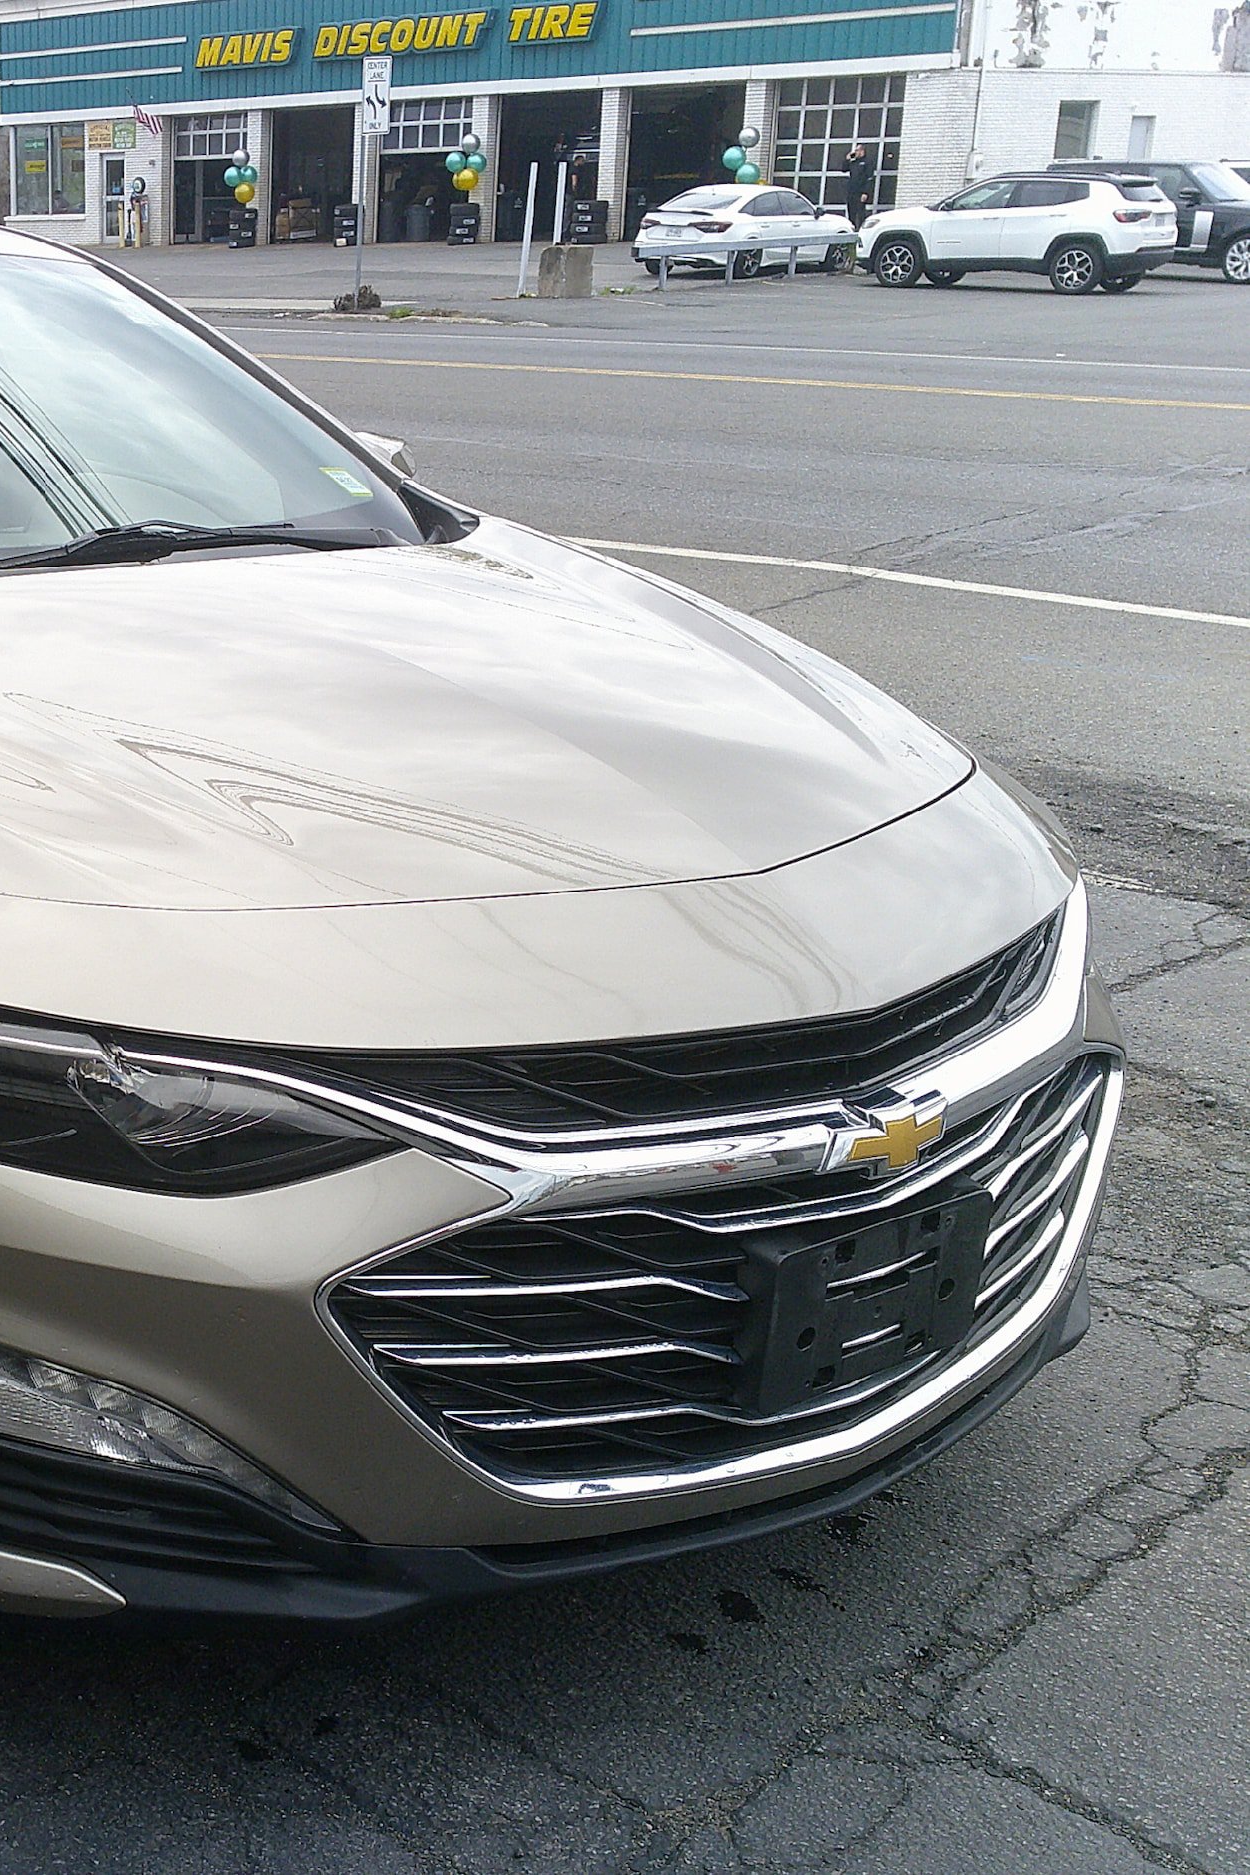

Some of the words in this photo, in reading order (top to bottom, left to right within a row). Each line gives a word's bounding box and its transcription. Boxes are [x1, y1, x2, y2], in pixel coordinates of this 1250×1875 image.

[194, 29, 294, 68] MAVIS
[312, 11, 488, 58] DISCOUNT
[508, 2, 598, 41] TIRE
[367, 61, 388, 70] CENTER
[369, 71, 385, 80] LANE
[369, 121, 382, 130] ONLY
